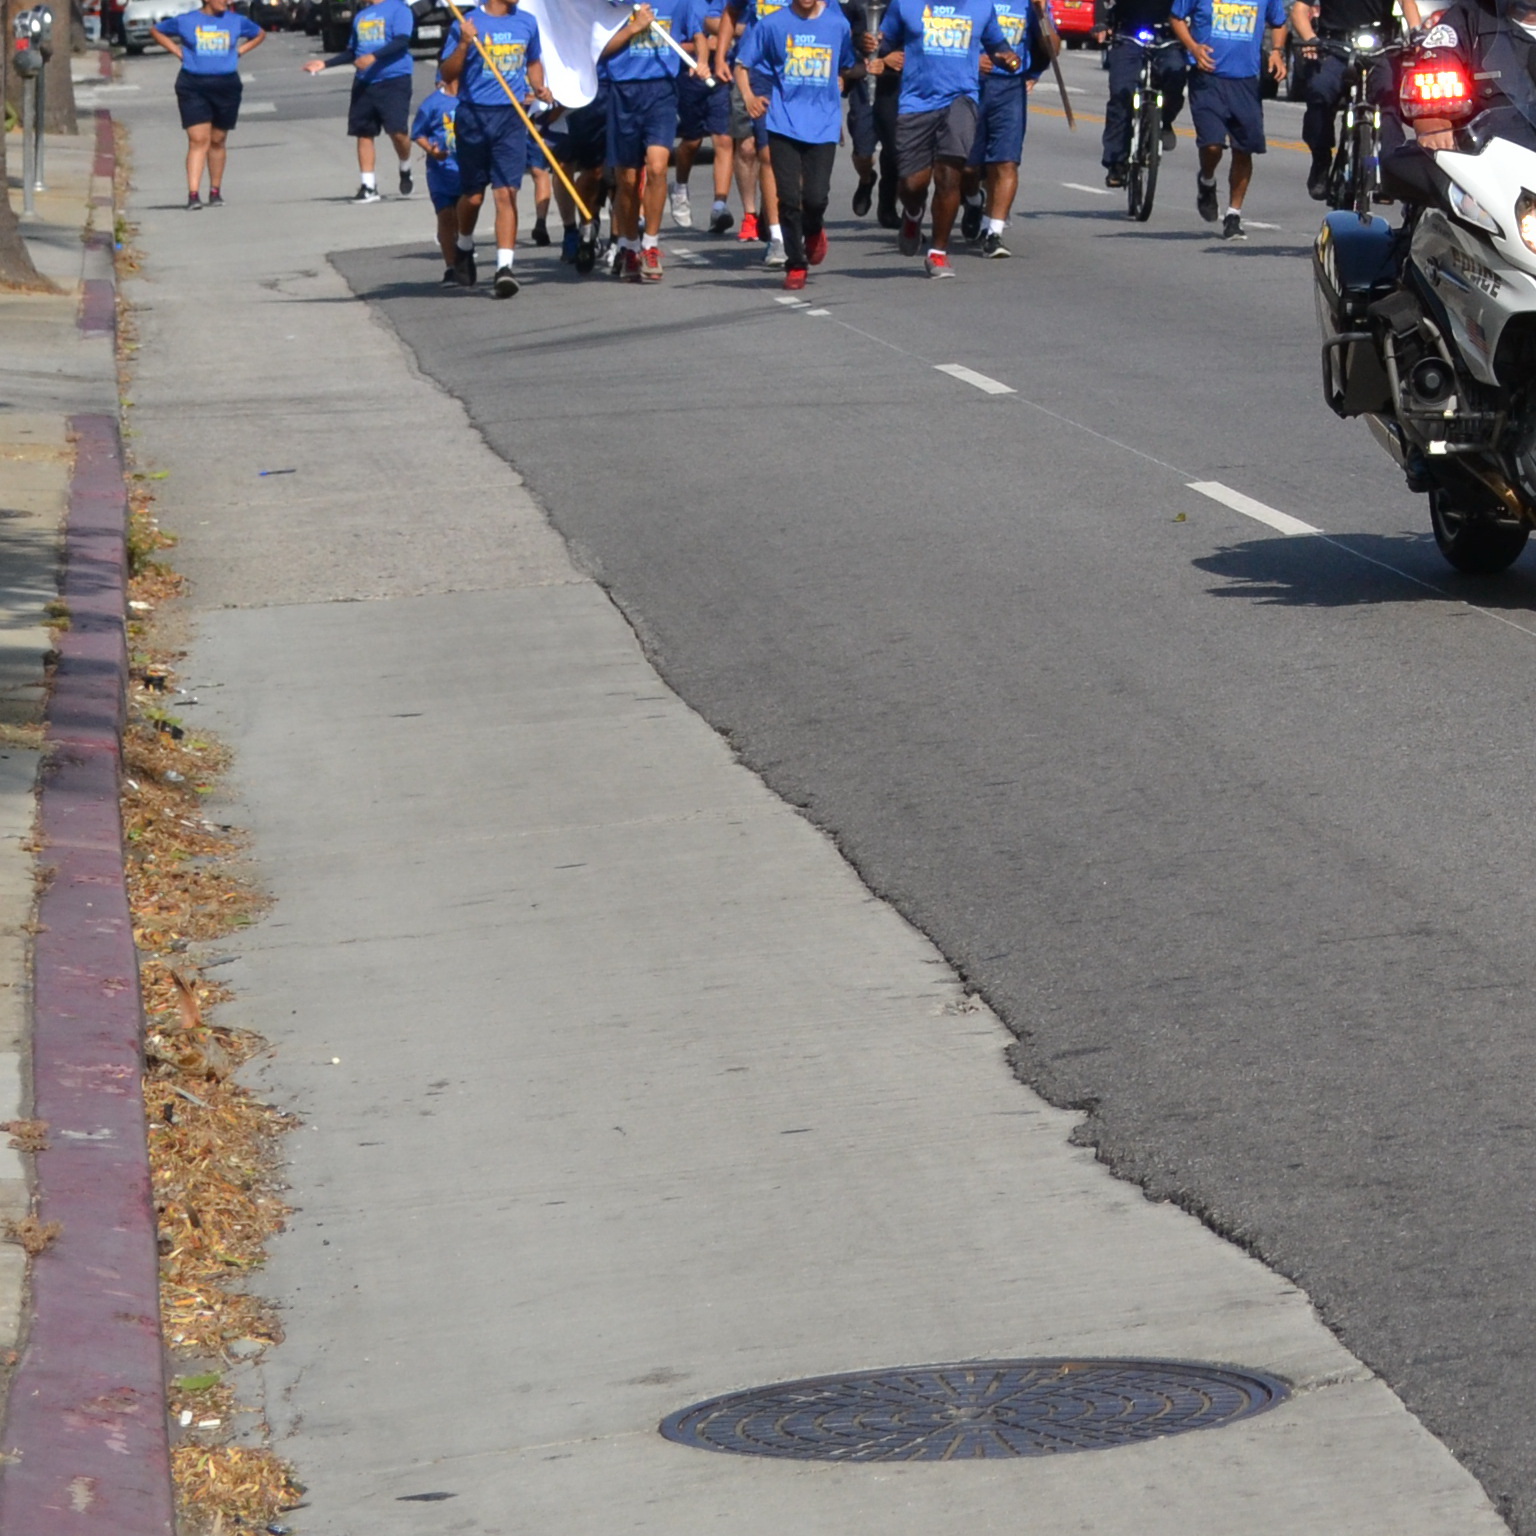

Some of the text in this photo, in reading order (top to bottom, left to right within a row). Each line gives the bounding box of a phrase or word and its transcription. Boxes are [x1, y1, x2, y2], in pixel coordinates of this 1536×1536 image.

[933, 5, 955, 15] 2017
[1212, 3, 1258, 17] TORCH
[922, 17, 972, 31] TORCH
[1212, 14, 1257, 34] RUN
[795, 34, 816, 44] 2017
[923, 28, 971, 49] RUN
[786, 46, 832, 61] TORCH
[784, 58, 831, 78] RUN
[1450, 245, 1502, 299] POLICE
